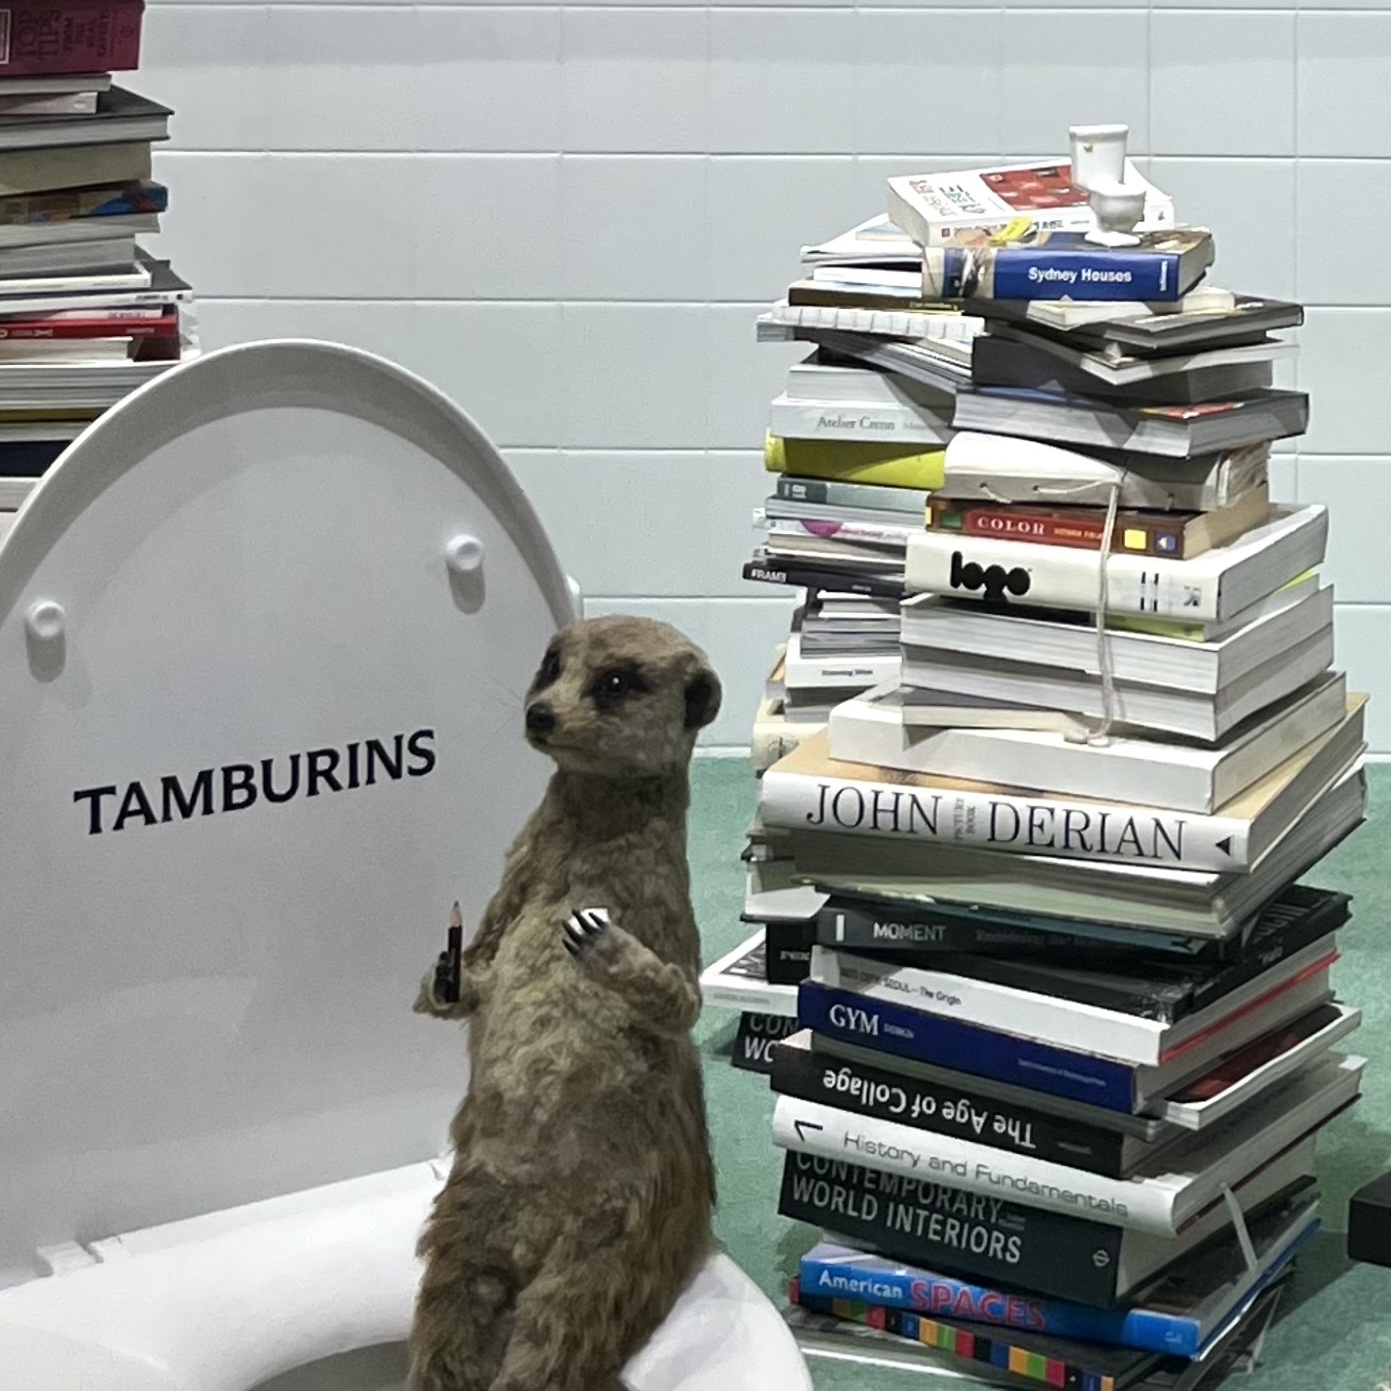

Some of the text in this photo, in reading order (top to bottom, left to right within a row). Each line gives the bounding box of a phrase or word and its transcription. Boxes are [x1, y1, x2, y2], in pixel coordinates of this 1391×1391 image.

[1028, 266, 1133, 283] Sydney Houses
[818, 416, 857, 429] Atelier
[977, 516, 1045, 535] COLOR
[73, 729, 436, 835] TAMBURINS
[805, 782, 1188, 861] JOHN DERIAN
[873, 921, 947, 942] MOMENT
[829, 1003, 880, 1036] GYM
[822, 1067, 1037, 1151] The Age of Collage
[796, 1152, 1006, 1225] CONTEMPORARY
[842, 1131, 1129, 1218] History and Fundamentals
[791, 1173, 1023, 1264] WORLD INTERIORS
[818, 1268, 1047, 1332] American SPACES
